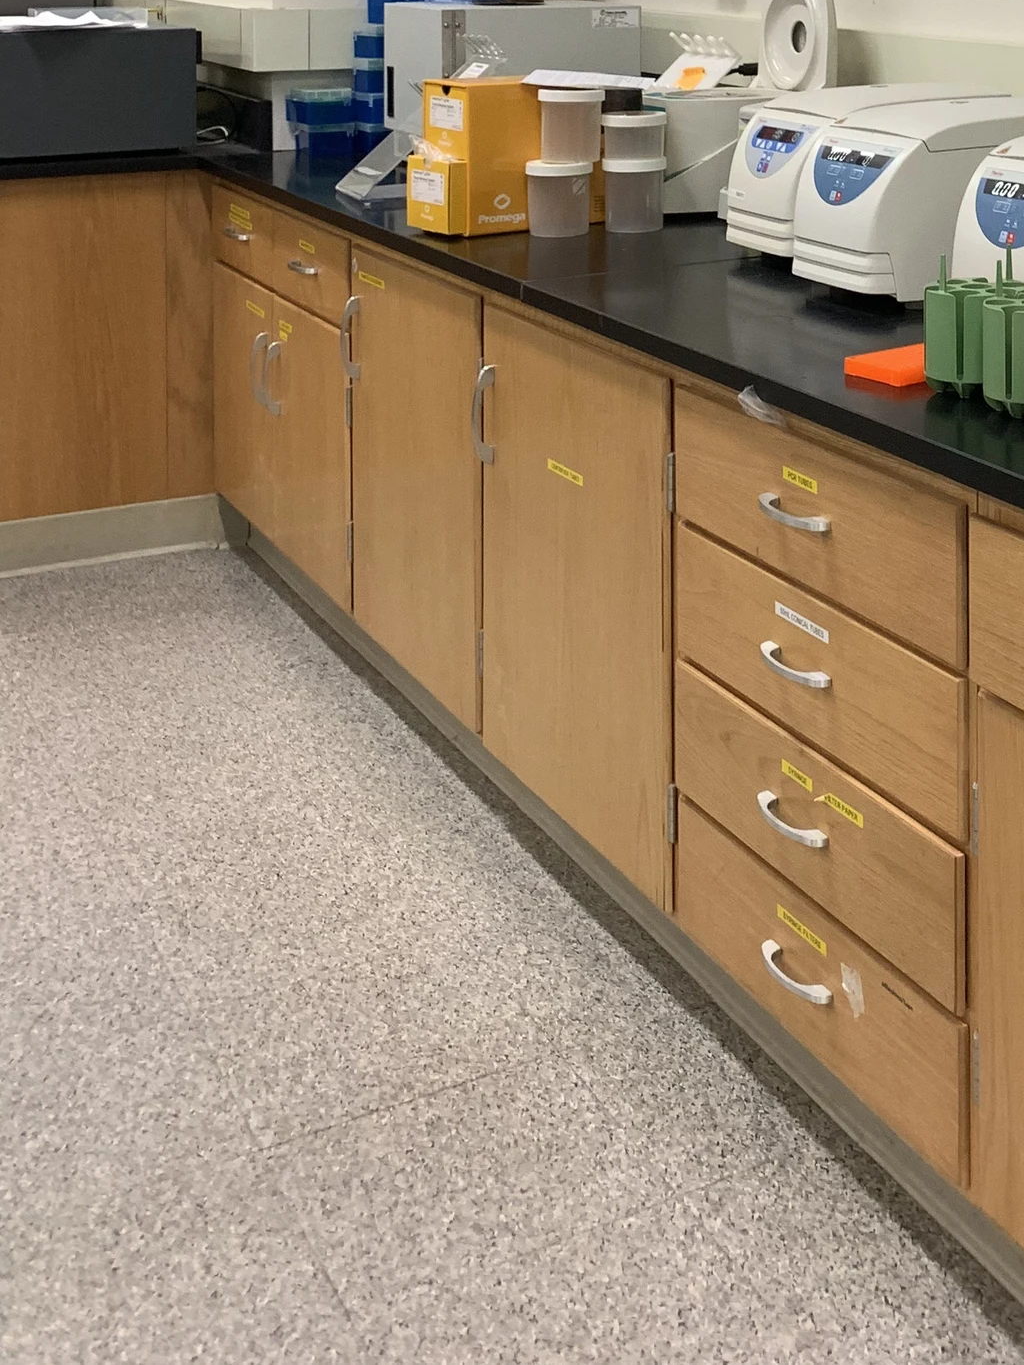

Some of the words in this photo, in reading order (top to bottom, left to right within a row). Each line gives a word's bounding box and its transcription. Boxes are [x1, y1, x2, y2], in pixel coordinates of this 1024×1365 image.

[478, 211, 526, 225] Promega
[791, 613, 809, 630] CONICAL
[810, 623, 824, 639] TUBES
[841, 804, 859, 823] PAPER
